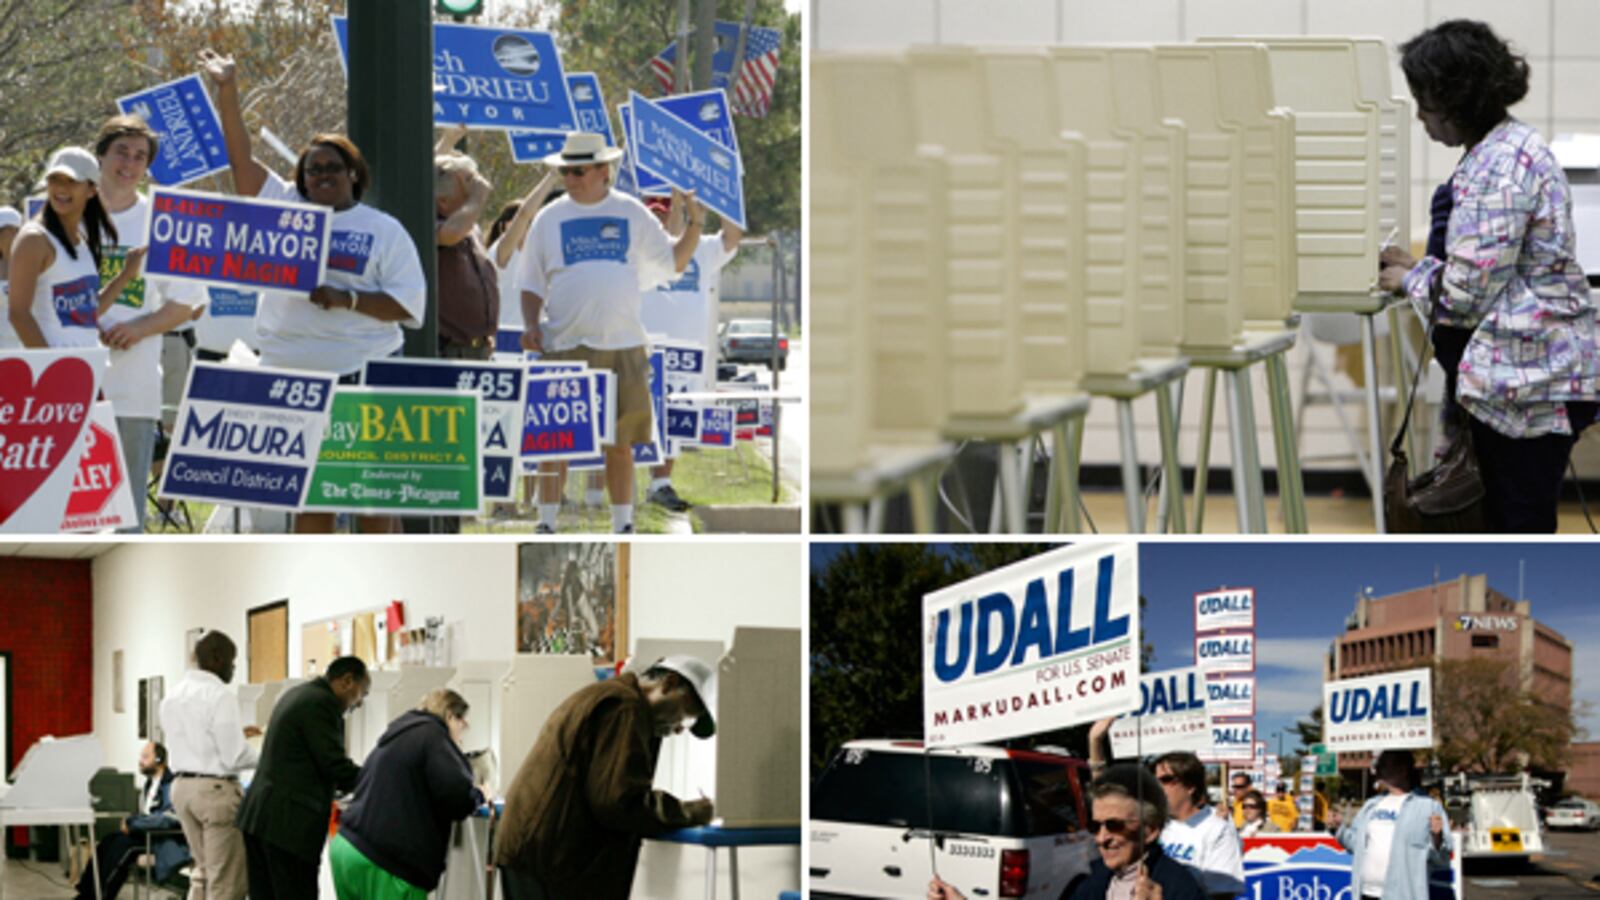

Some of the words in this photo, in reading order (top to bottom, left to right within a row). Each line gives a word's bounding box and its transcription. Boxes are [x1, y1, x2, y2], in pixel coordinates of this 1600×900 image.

[638, 120, 739, 199] LANDRIEU
[153, 213, 213, 249] OUR
[224, 221, 319, 261] MAYOR
[277, 211, 317, 233] #63
[168, 246, 216, 276] RAY
[221, 252, 299, 287] NAGIN
[268, 378, 324, 408] #85
[456, 371, 514, 398] #85
[546, 380, 582, 399] #63
[0, 401, 15, 424] e
[18, 397, 84, 424] Love
[524, 401, 589, 426] AYOR
[180, 405, 307, 460] MIDURA
[384, 452, 451, 462] DISTRICT
[456, 454, 466, 463] A
[171, 461, 230, 485] Council
[231, 468, 284, 491] District
[285, 475, 299, 492] A
[320, 480, 347, 499] The
[933, 554, 1131, 683] UDALL
[1199, 594, 1251, 616] UDALL
[1199, 638, 1251, 658] UDALL
[1036, 665, 1061, 684] FOR
[1062, 657, 1083, 677] U.S.
[1086, 645, 1132, 671] SENATE
[933, 669, 1127, 727] MARKUDALL.COM
[1115, 672, 1205, 719] DALL
[1329, 680, 1428, 725] UDALL
